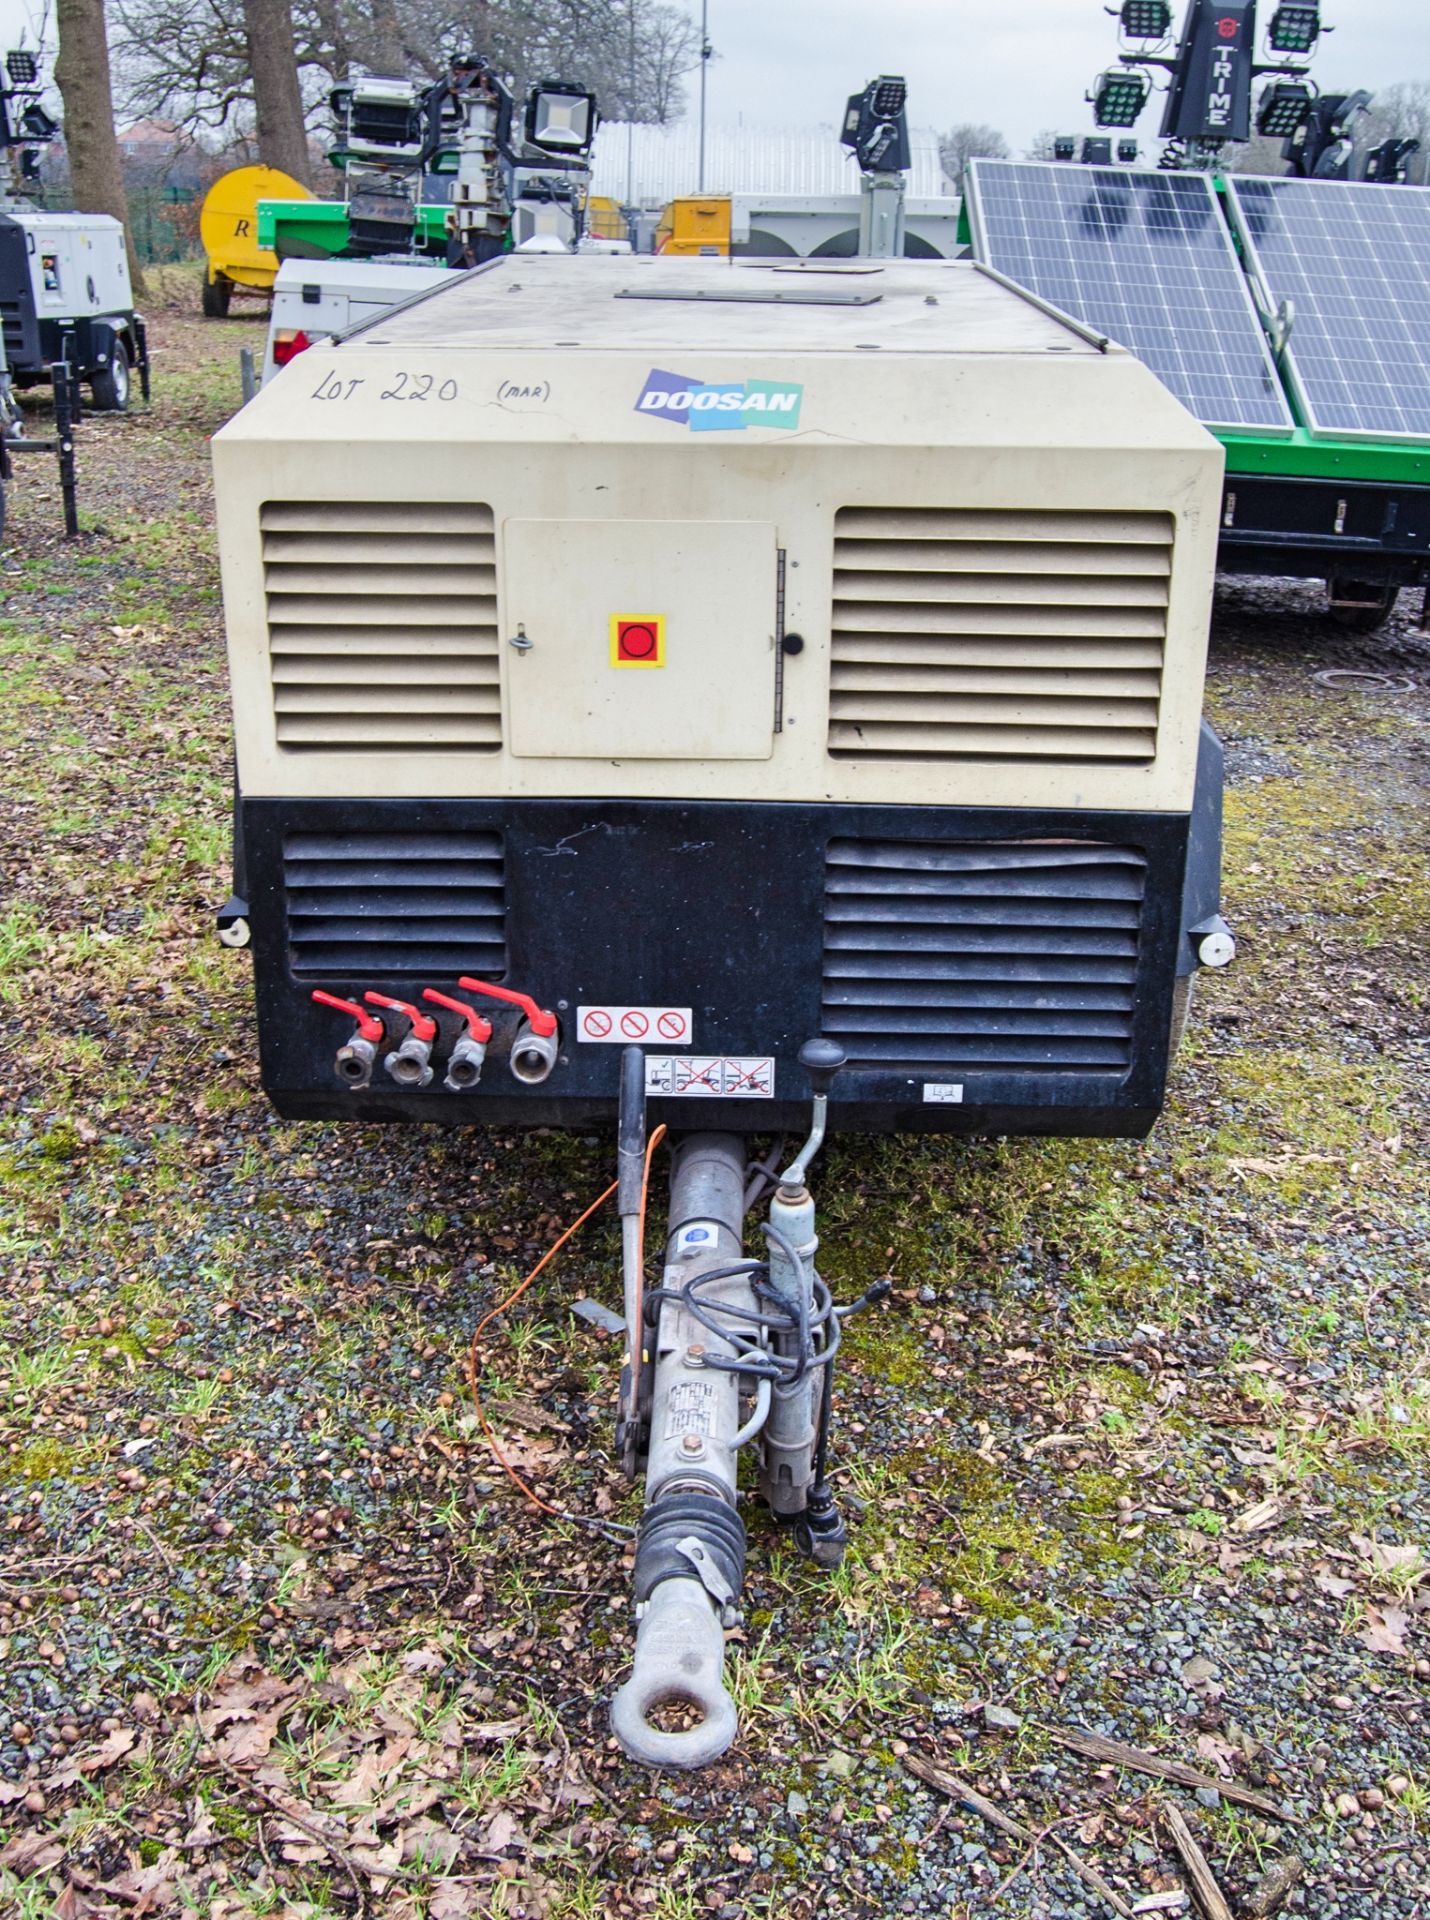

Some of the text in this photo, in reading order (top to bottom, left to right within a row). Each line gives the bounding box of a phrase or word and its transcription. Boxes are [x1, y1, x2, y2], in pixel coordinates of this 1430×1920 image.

[1208, 45, 1235, 126] TRIME
[234, 219, 250, 238] R
[310, 369, 365, 401] LOT
[380, 372, 458, 401] 220
[639, 391, 799, 411] DOOSAN
